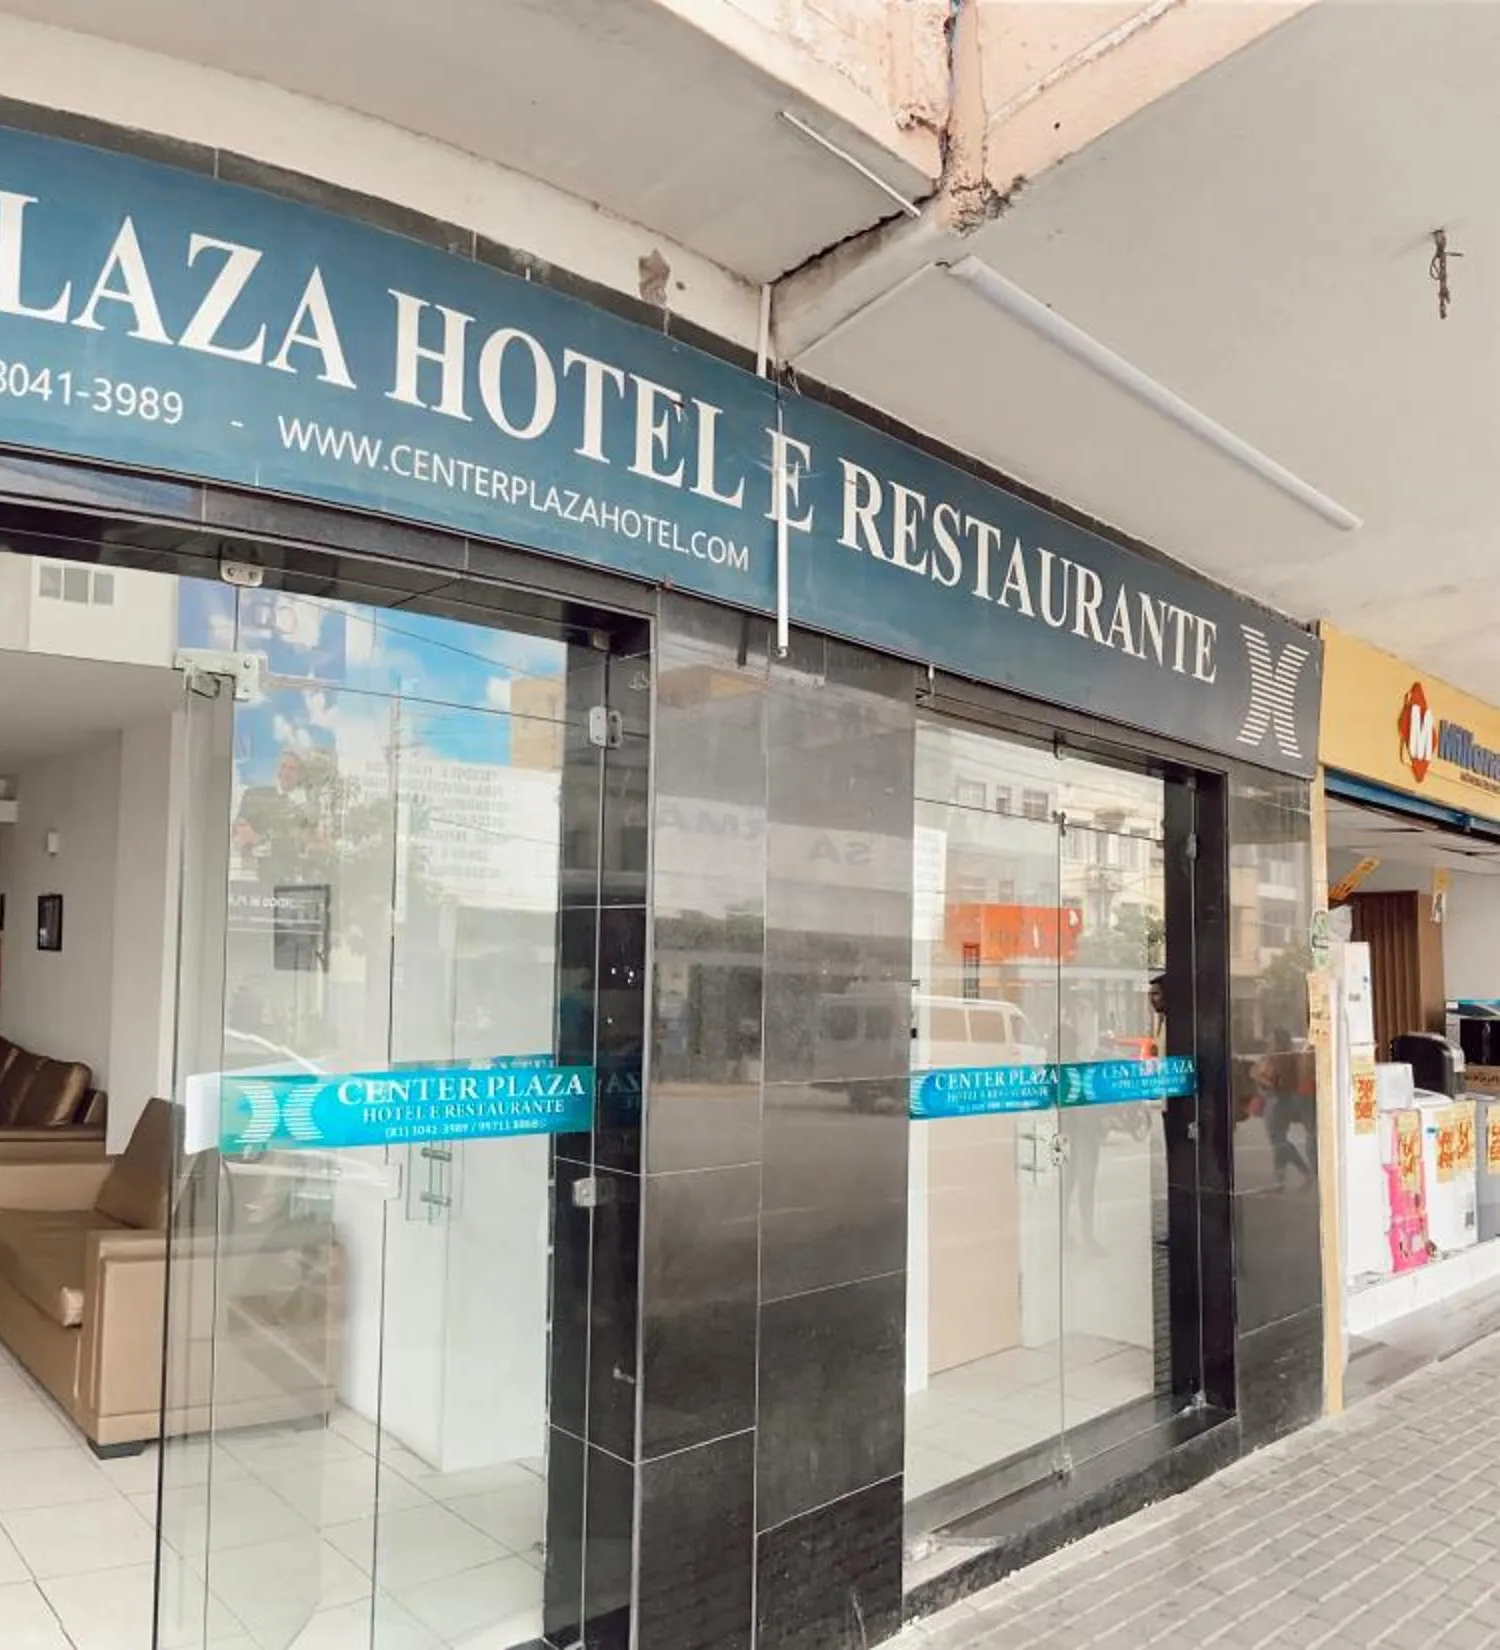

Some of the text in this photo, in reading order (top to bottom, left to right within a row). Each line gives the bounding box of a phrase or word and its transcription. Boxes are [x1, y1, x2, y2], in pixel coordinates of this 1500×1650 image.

[278, 415, 750, 572] WWW.CENTERPLAZAHOTEL.COM
[385, 287, 746, 509] HOTEL
[764, 426, 815, 534] E
[836, 456, 1218, 685] RESTAURANTE
[337, 1076, 479, 1105] CENTER
[487, 1073, 586, 1098] PLAZA
[935, 1066, 1060, 1091] CENTER PLAZA
[363, 1104, 423, 1123] HOTEL
[444, 1099, 565, 1118] RESTAURANTE
